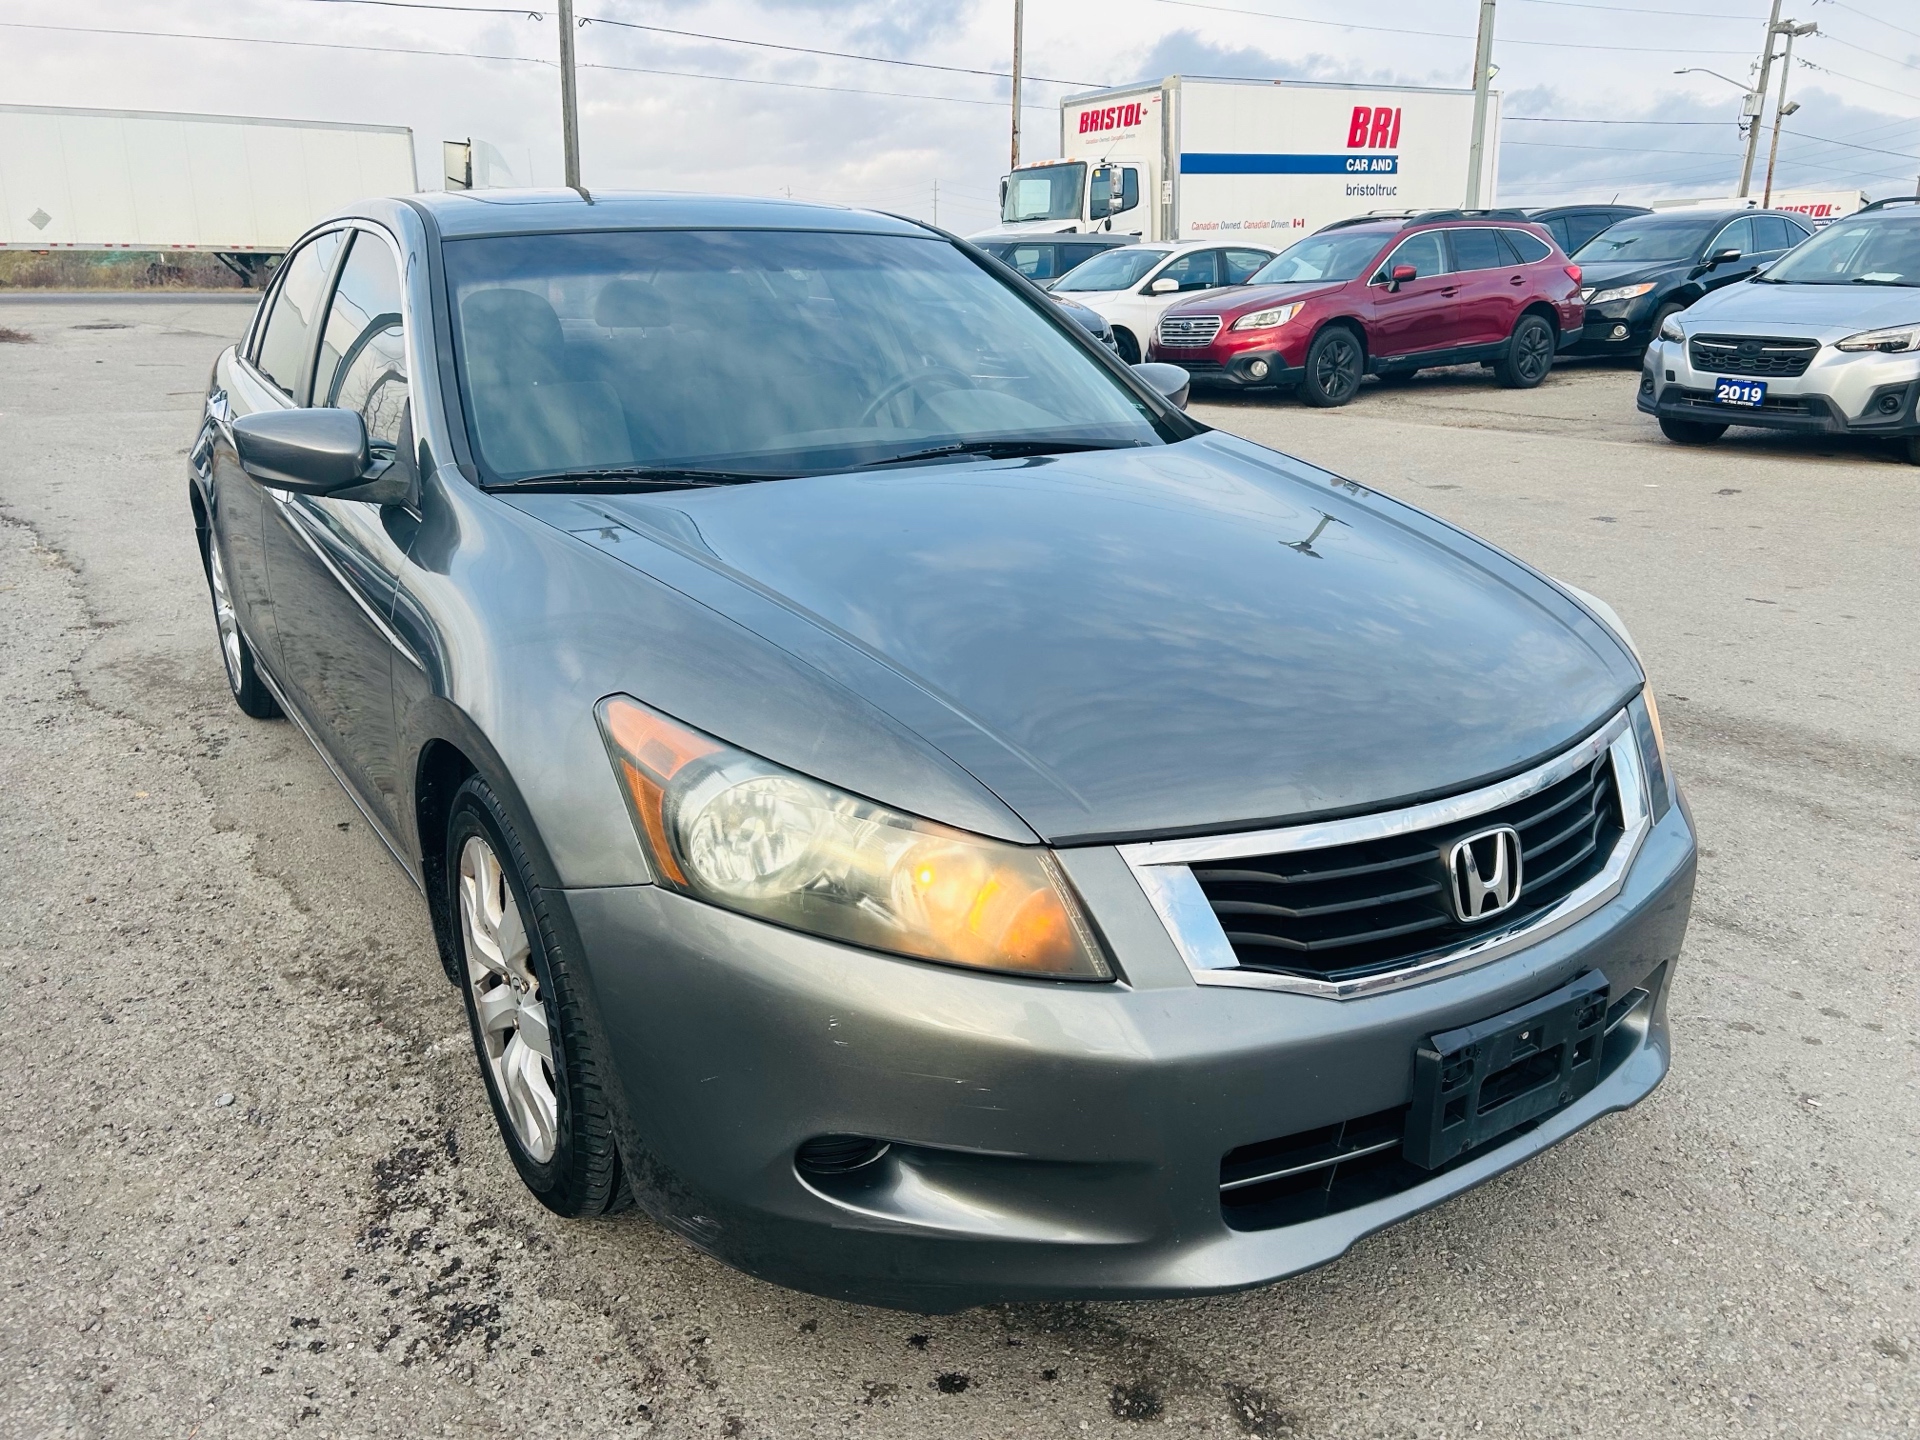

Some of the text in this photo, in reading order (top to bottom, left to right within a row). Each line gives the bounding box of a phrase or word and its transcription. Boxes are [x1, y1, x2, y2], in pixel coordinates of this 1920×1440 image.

[1079, 103, 1142, 134] BRISTOL
[1346, 106, 1401, 149] BRI
[1346, 159, 1368, 171] CAR
[1370, 159, 1393, 171] AND
[1346, 183, 1397, 196] bristoltruc
[1191, 221, 1219, 231] Canadian
[1243, 220, 1270, 230] Canadian
[1717, 384, 1762, 402] 2019
